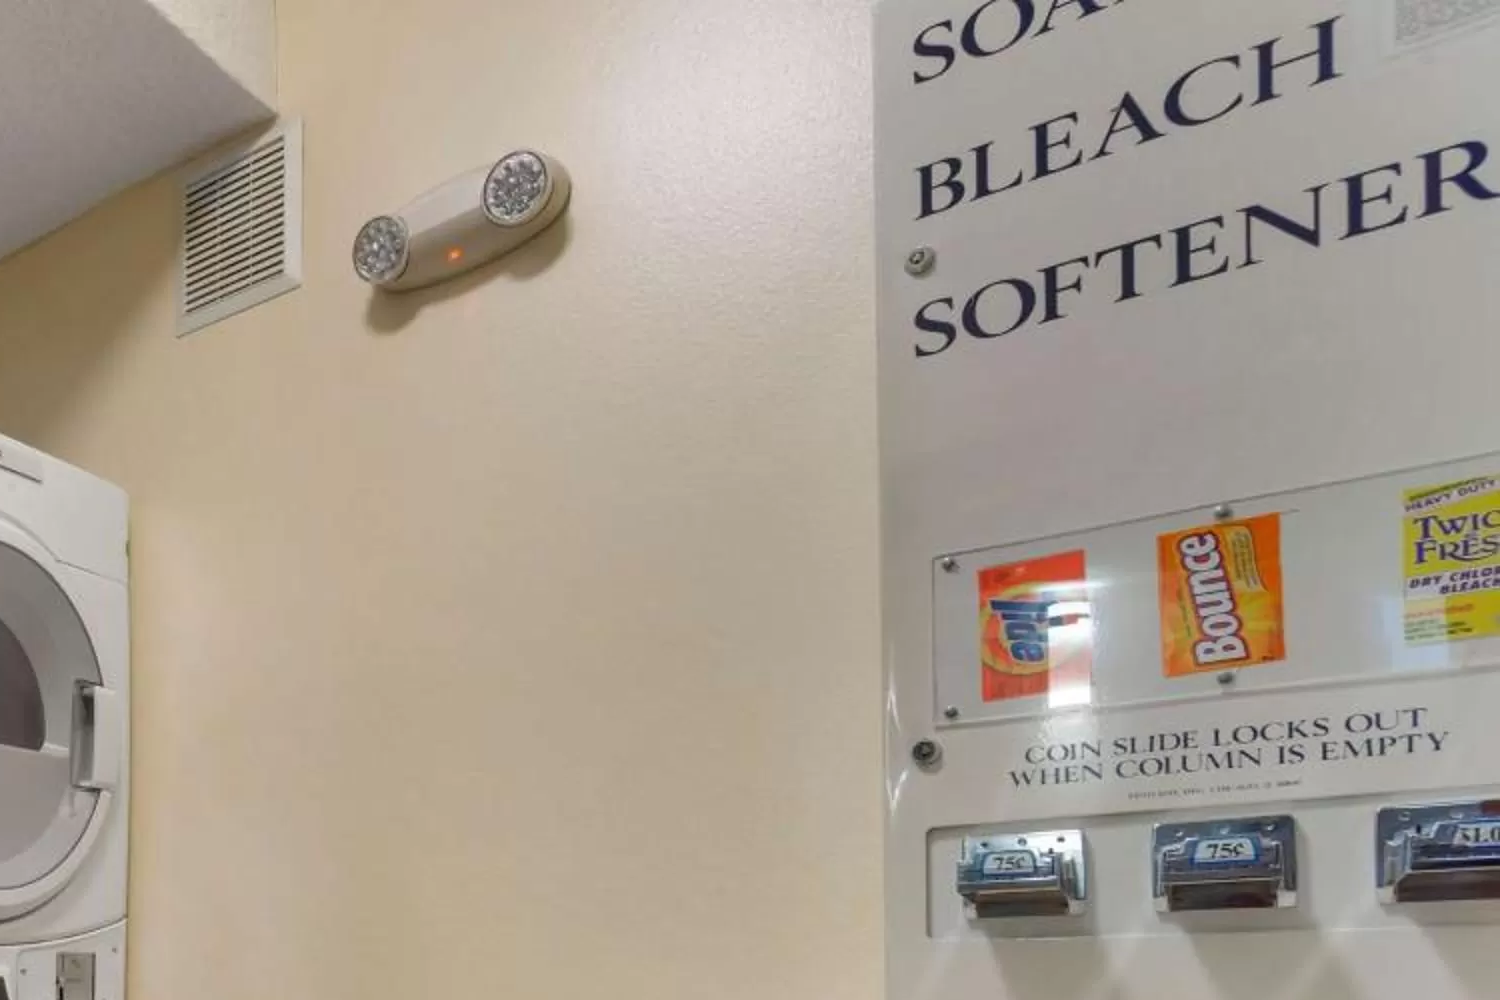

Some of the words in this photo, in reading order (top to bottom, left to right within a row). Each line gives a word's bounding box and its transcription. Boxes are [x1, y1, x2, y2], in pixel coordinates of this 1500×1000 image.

[914, 14, 1344, 220] BLEACH
[913, 140, 1500, 357] SOFTENER
[1405, 493, 1451, 512] HEAVY
[1458, 479, 1495, 496] DUTY
[1179, 532, 1248, 666] Bounce
[1409, 575, 1442, 589] DRY
[1009, 763, 1103, 788] WHEN
[1115, 748, 1262, 779] COLUMN
[1278, 743, 1306, 765] IS
[1321, 731, 1449, 761] EMPTY
[1024, 739, 1101, 765] COIN
[1113, 730, 1199, 757] SLIDE
[1212, 717, 1330, 746] LOCKS
[1344, 707, 1428, 733] OUT
